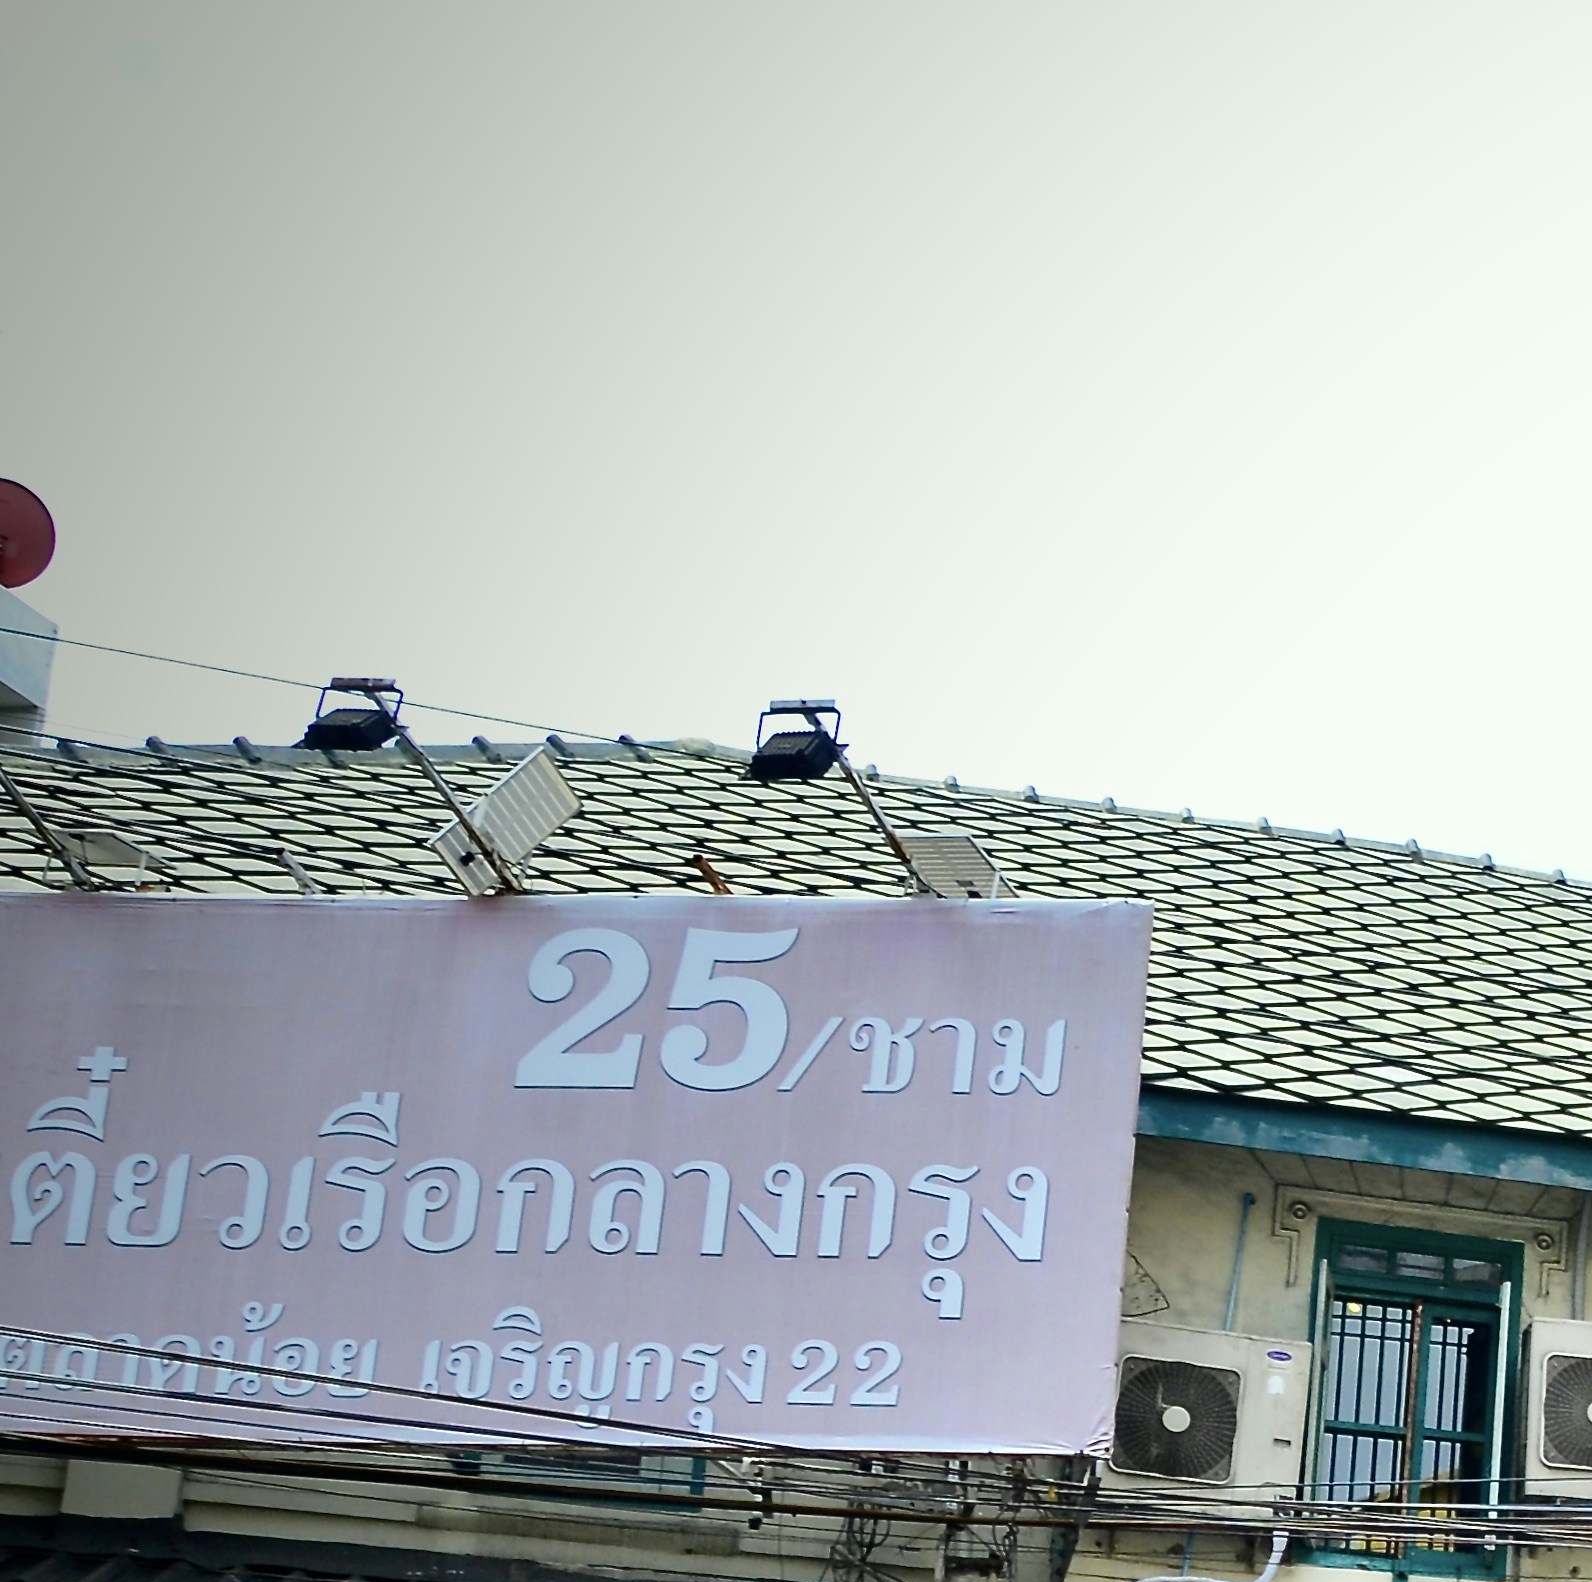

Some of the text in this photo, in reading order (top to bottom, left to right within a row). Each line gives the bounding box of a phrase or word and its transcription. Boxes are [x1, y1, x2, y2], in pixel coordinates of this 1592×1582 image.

[9, 1045, 1048, 1319] ตี๋ยวเรือกลางกรุง
